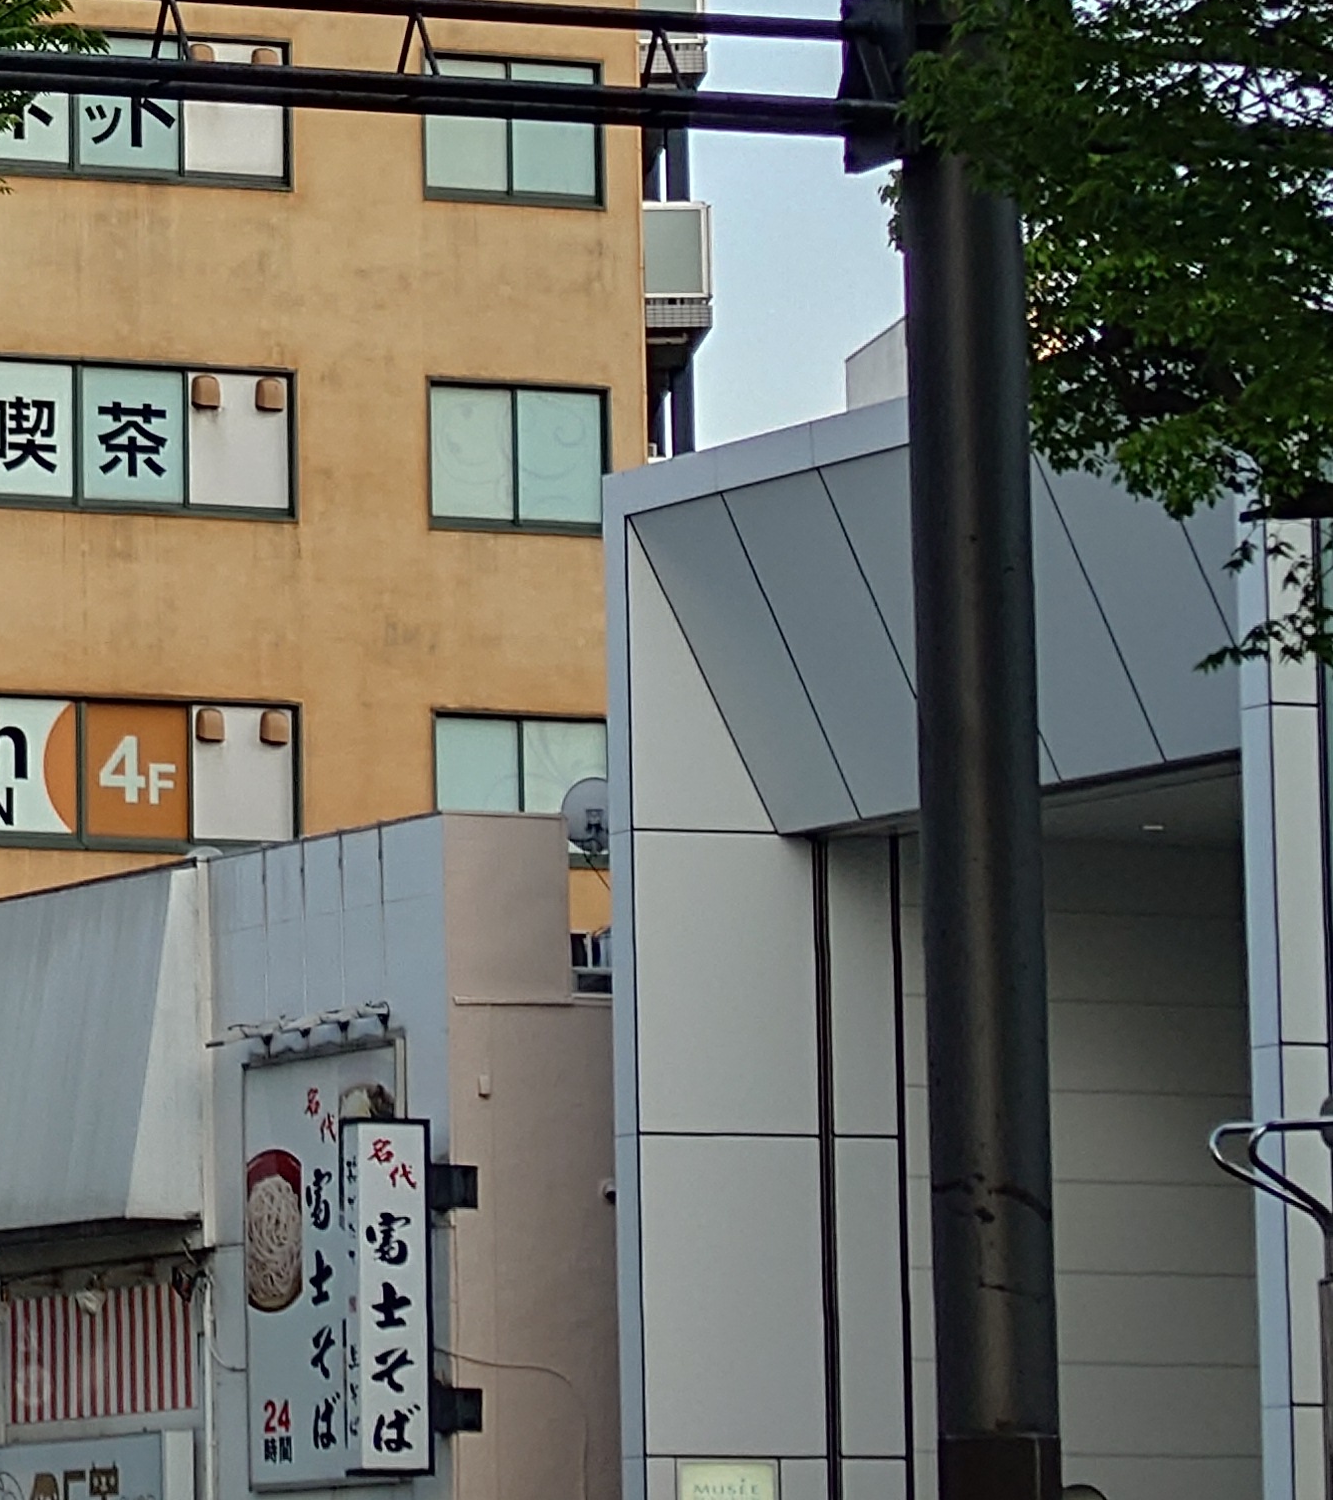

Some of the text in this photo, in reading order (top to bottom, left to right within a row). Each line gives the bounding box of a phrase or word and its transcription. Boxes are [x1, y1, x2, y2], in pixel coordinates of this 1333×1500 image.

[99, 735, 178, 806] 4F
[304, 1168, 340, 1451] 富士そば
[365, 1212, 422, 1455] 富士そば
[263, 1399, 292, 1434] 24
[263, 1436, 293, 1465] 時間
